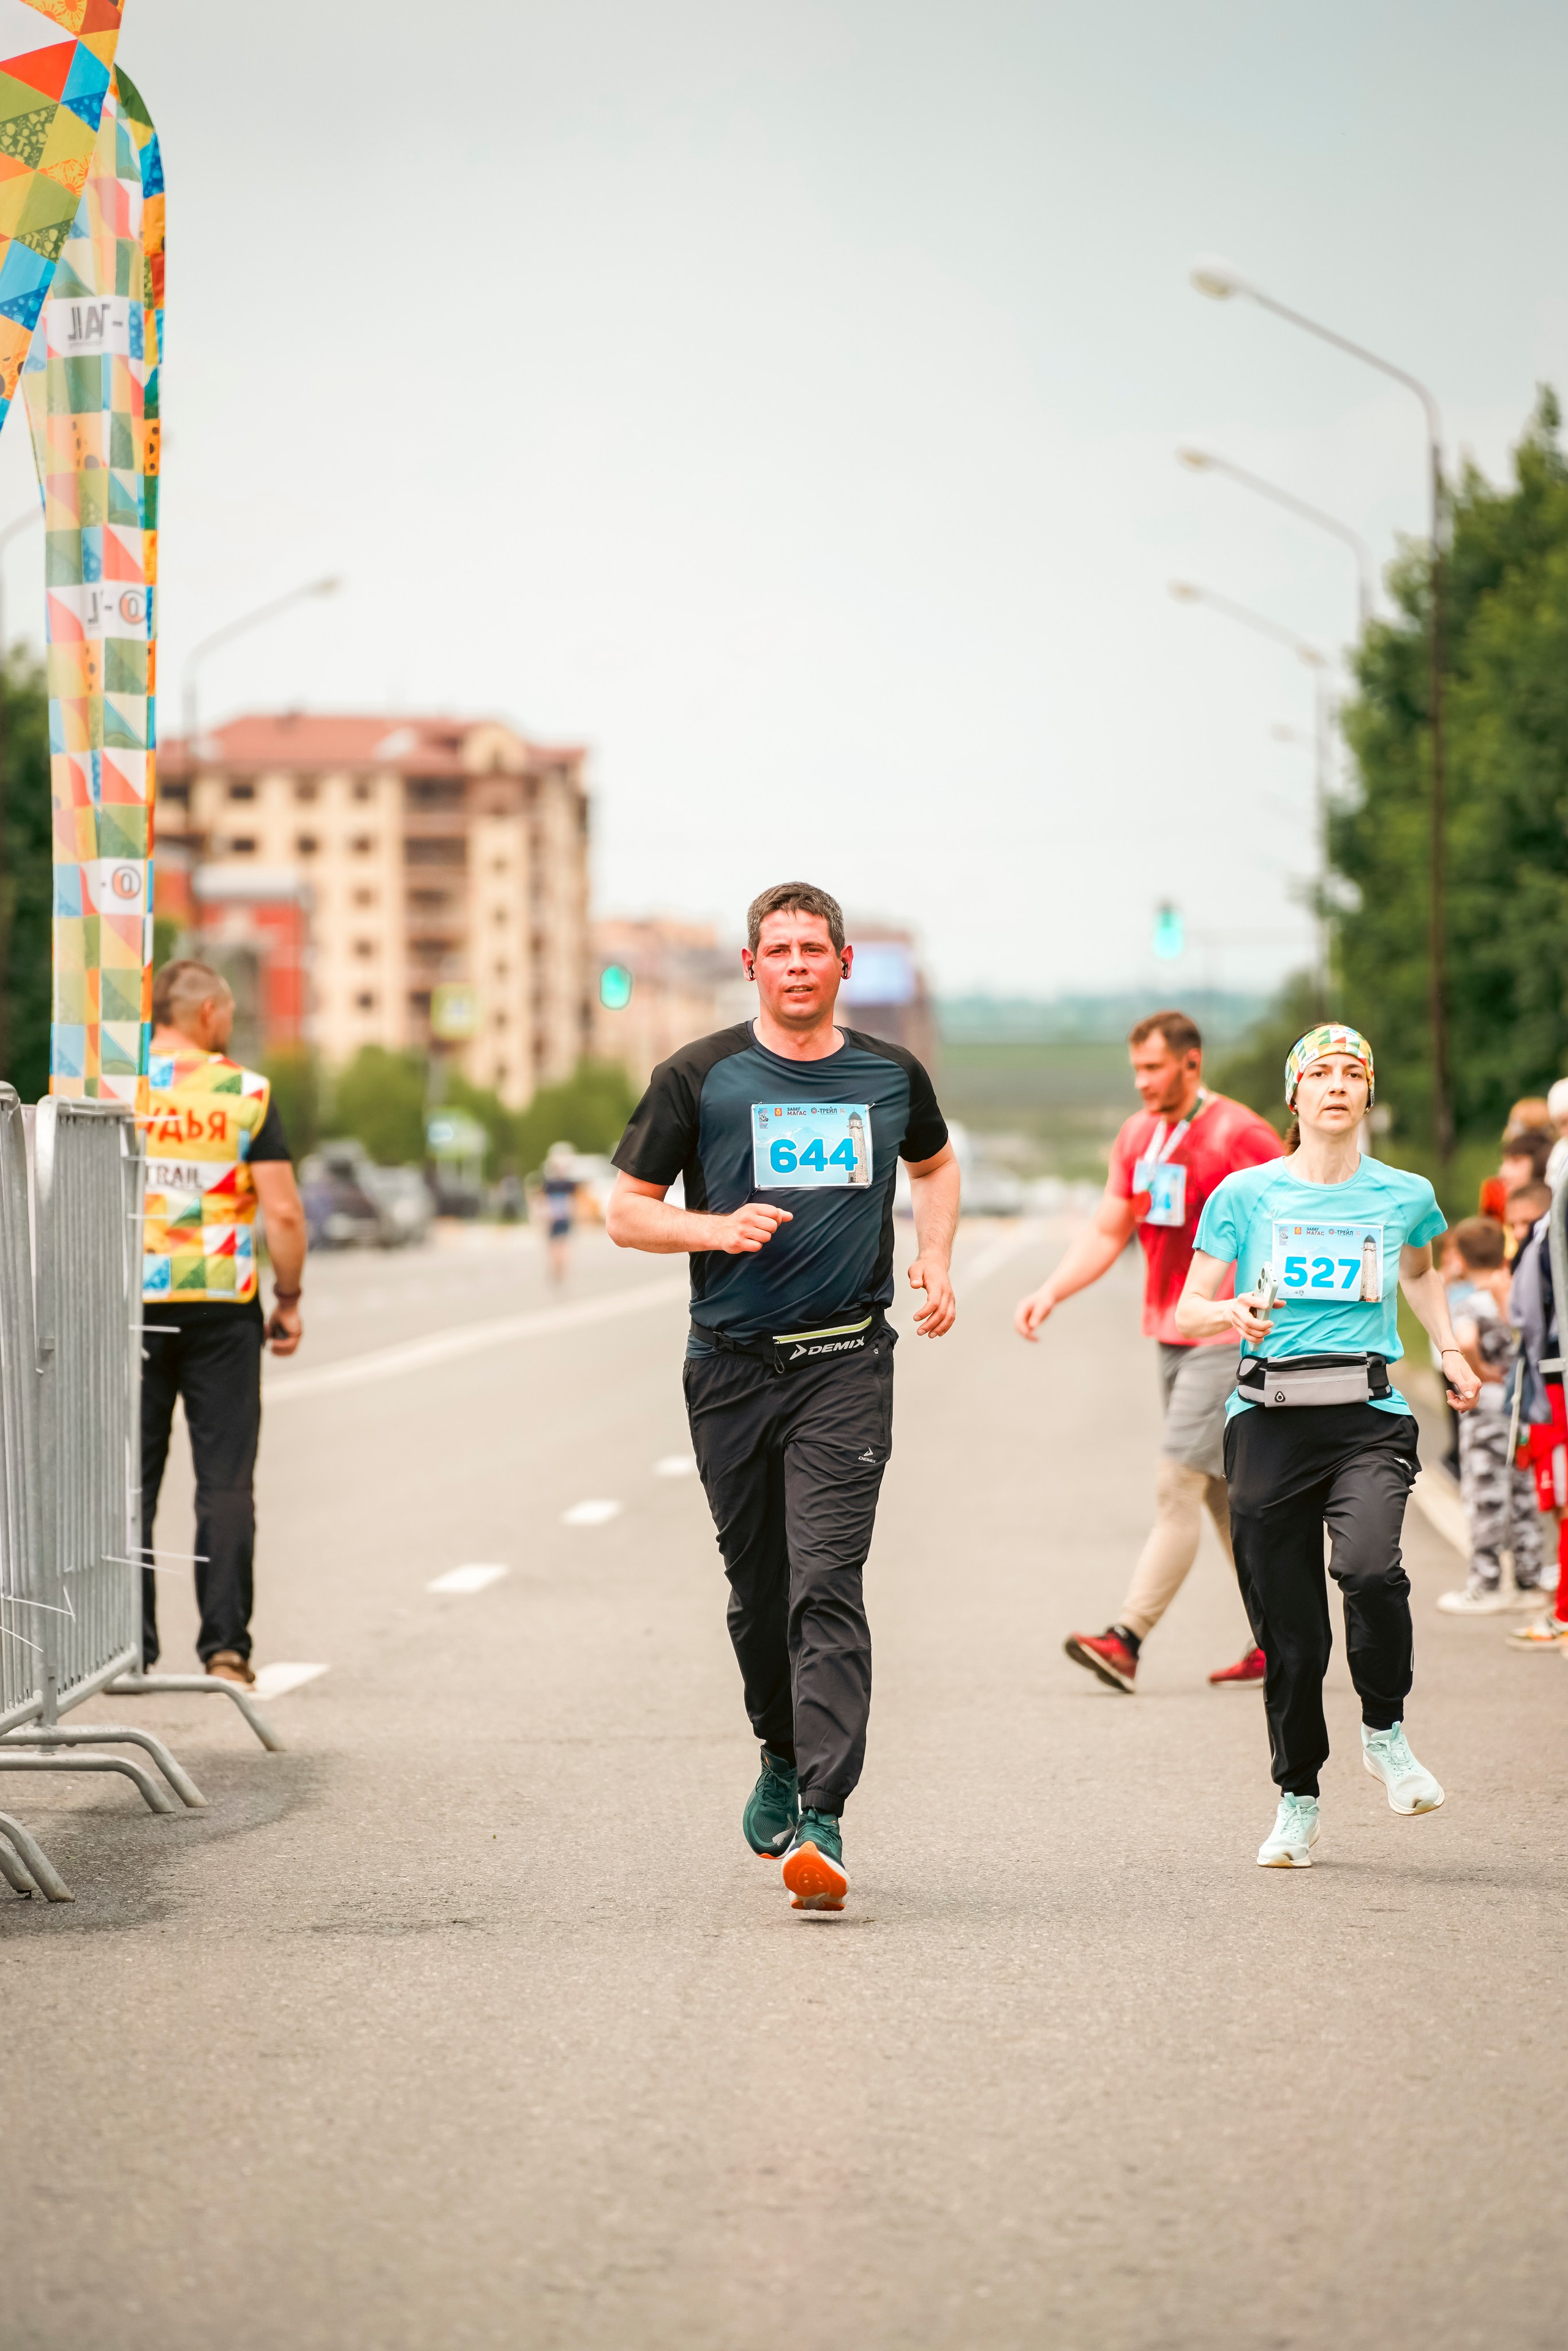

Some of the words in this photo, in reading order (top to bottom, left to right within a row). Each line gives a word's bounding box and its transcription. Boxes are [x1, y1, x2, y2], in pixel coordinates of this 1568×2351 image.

[770, 1138, 858, 1174] 644
[1283, 1256, 1361, 1289] 527
[807, 1335, 865, 1356] DEMIX
[858, 1455, 876, 1464] DEMIX
